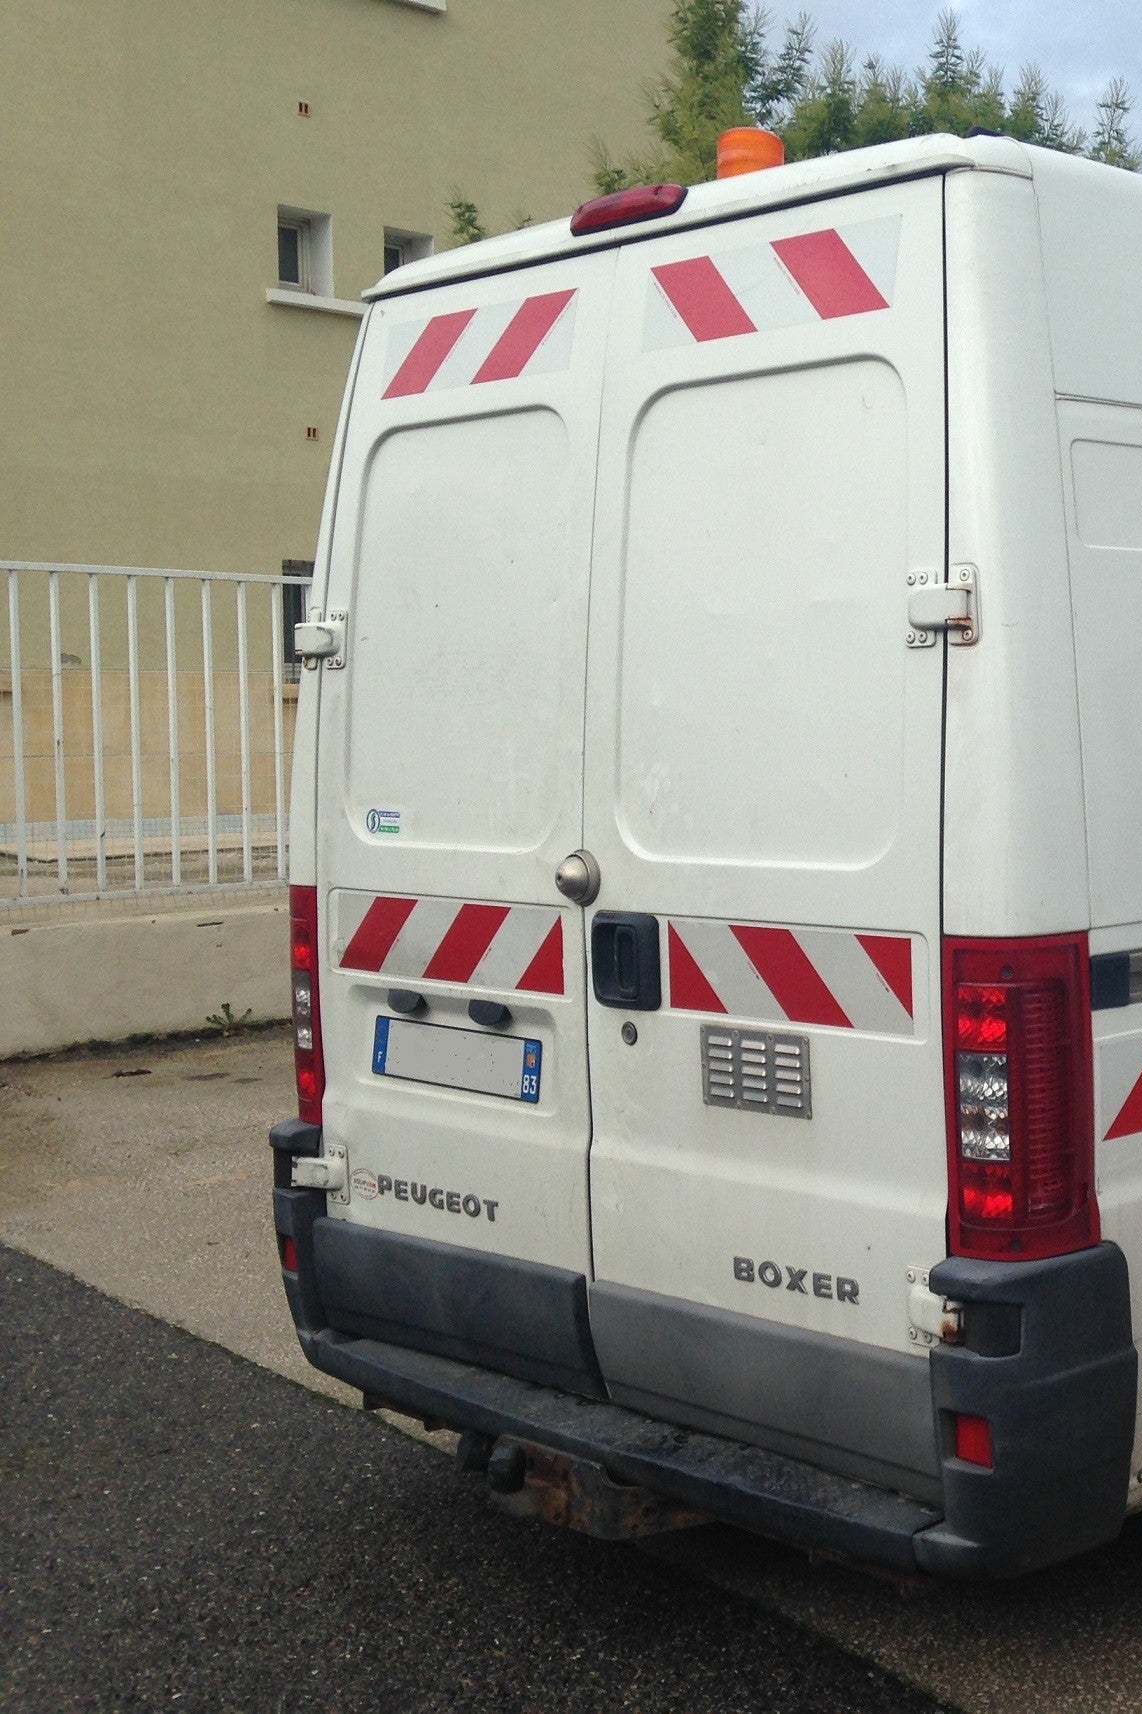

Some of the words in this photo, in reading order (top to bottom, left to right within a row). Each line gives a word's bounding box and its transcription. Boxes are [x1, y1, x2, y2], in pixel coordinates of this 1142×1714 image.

[522, 1074, 537, 1095] 83
[377, 1173, 499, 1222] PEUGEOT
[733, 1255, 860, 1305] BOXER
